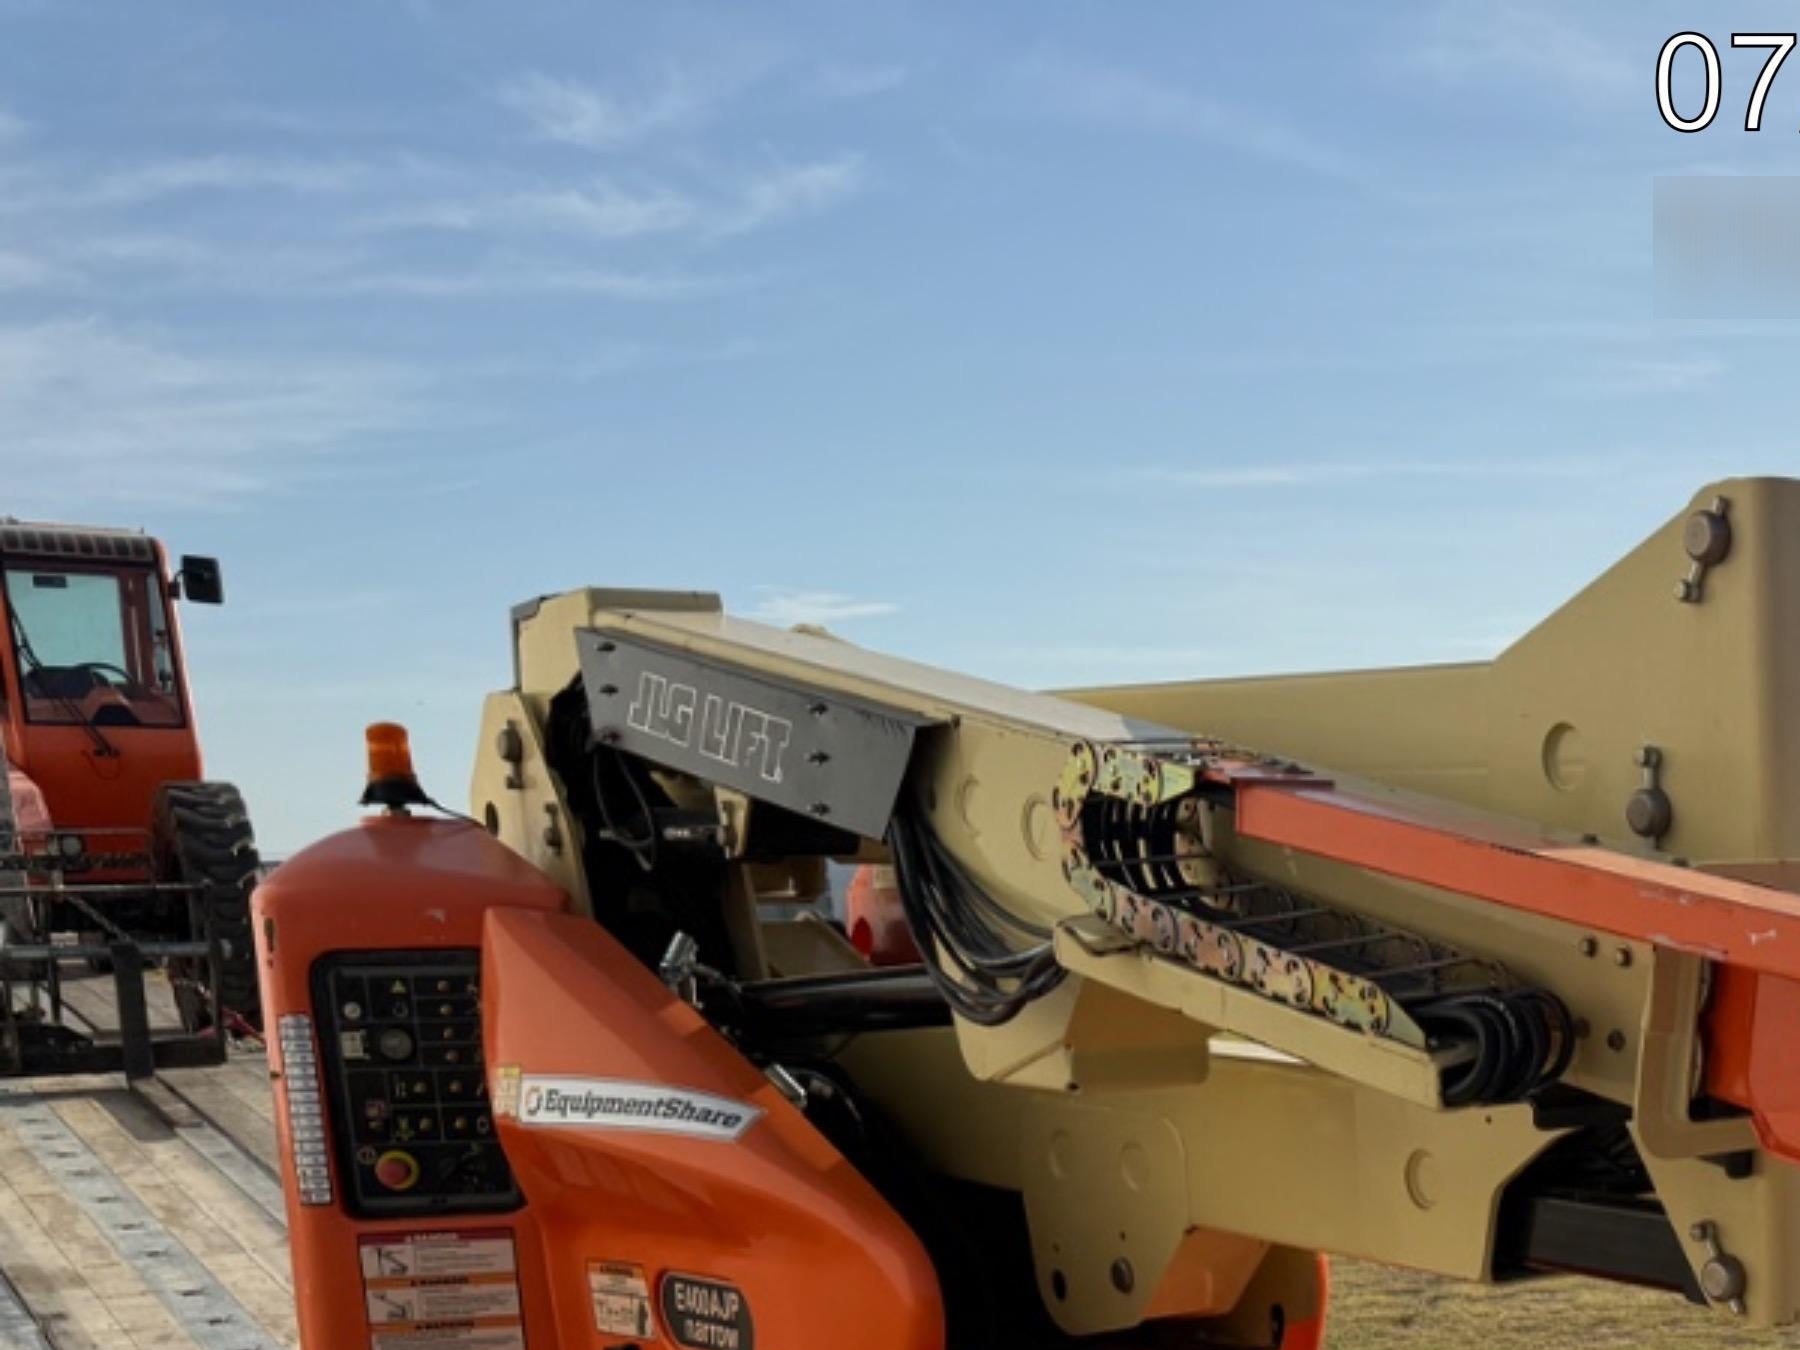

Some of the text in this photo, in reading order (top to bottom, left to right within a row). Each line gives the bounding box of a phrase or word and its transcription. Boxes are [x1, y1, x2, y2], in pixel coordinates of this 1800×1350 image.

[627, 671, 792, 784] JLG LIFT
[544, 1088, 742, 1129] EquipmentShare
